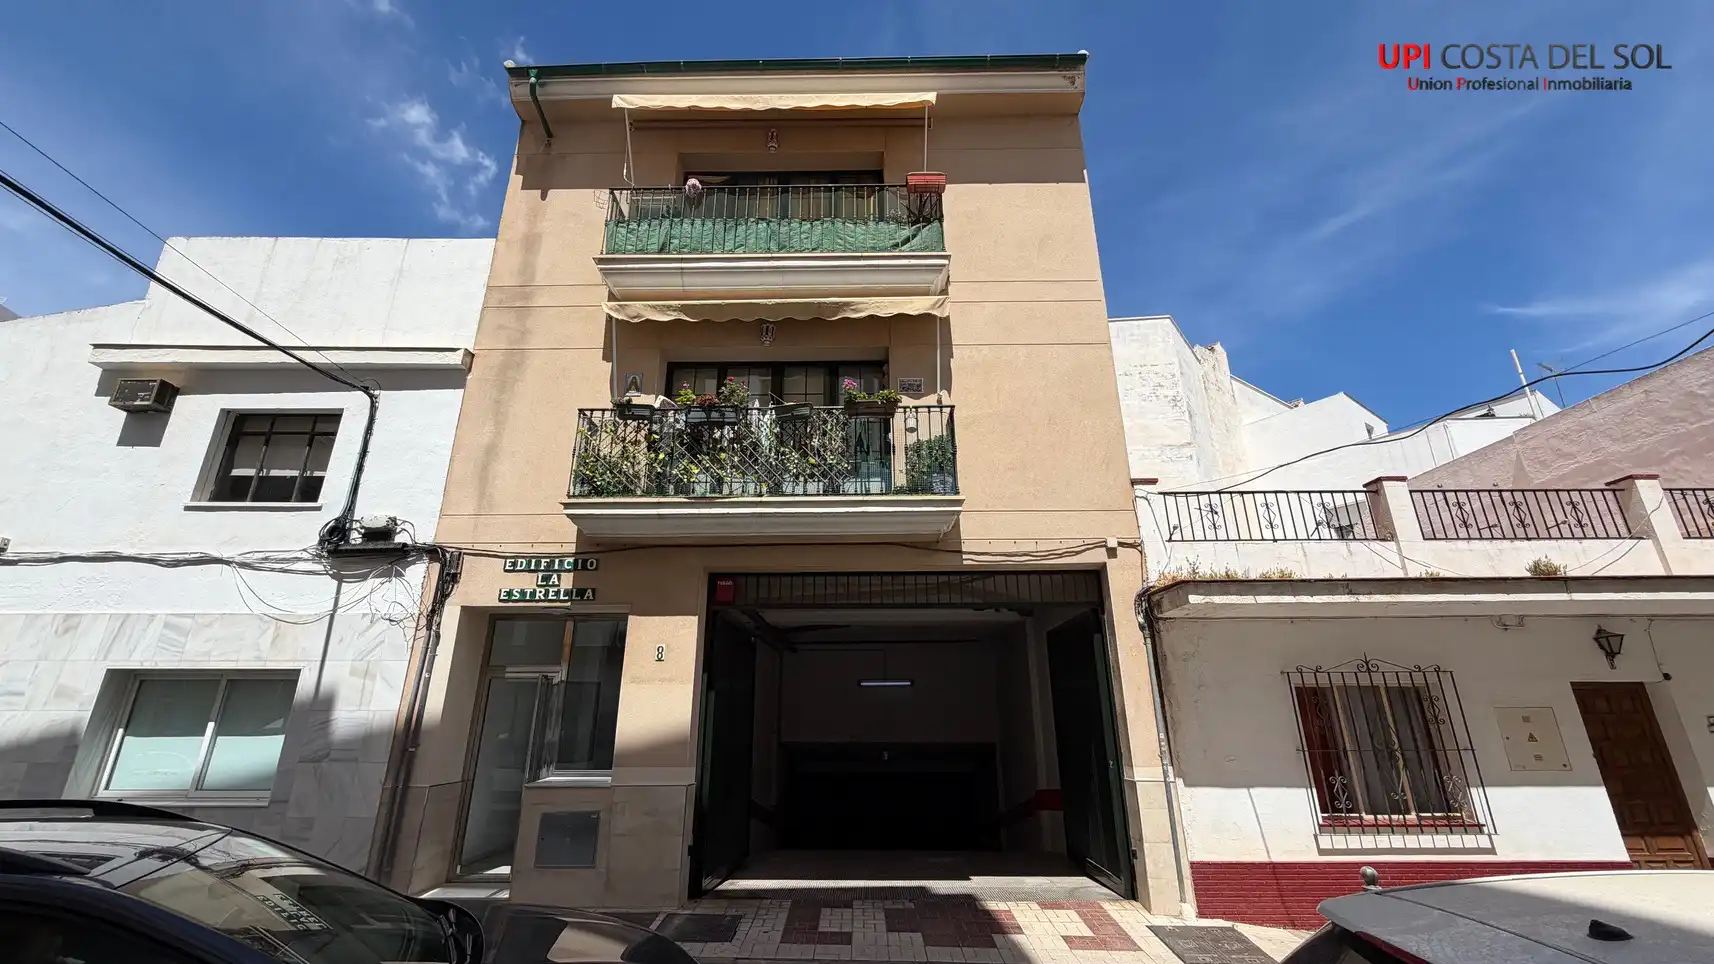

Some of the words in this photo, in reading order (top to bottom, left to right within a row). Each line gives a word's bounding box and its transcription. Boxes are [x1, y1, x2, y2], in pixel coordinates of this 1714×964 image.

[504, 558, 598, 570] EDIFICIO
[537, 573, 560, 585] LA
[499, 588, 595, 600] ESTRELLA
[656, 645, 664, 660] 8
